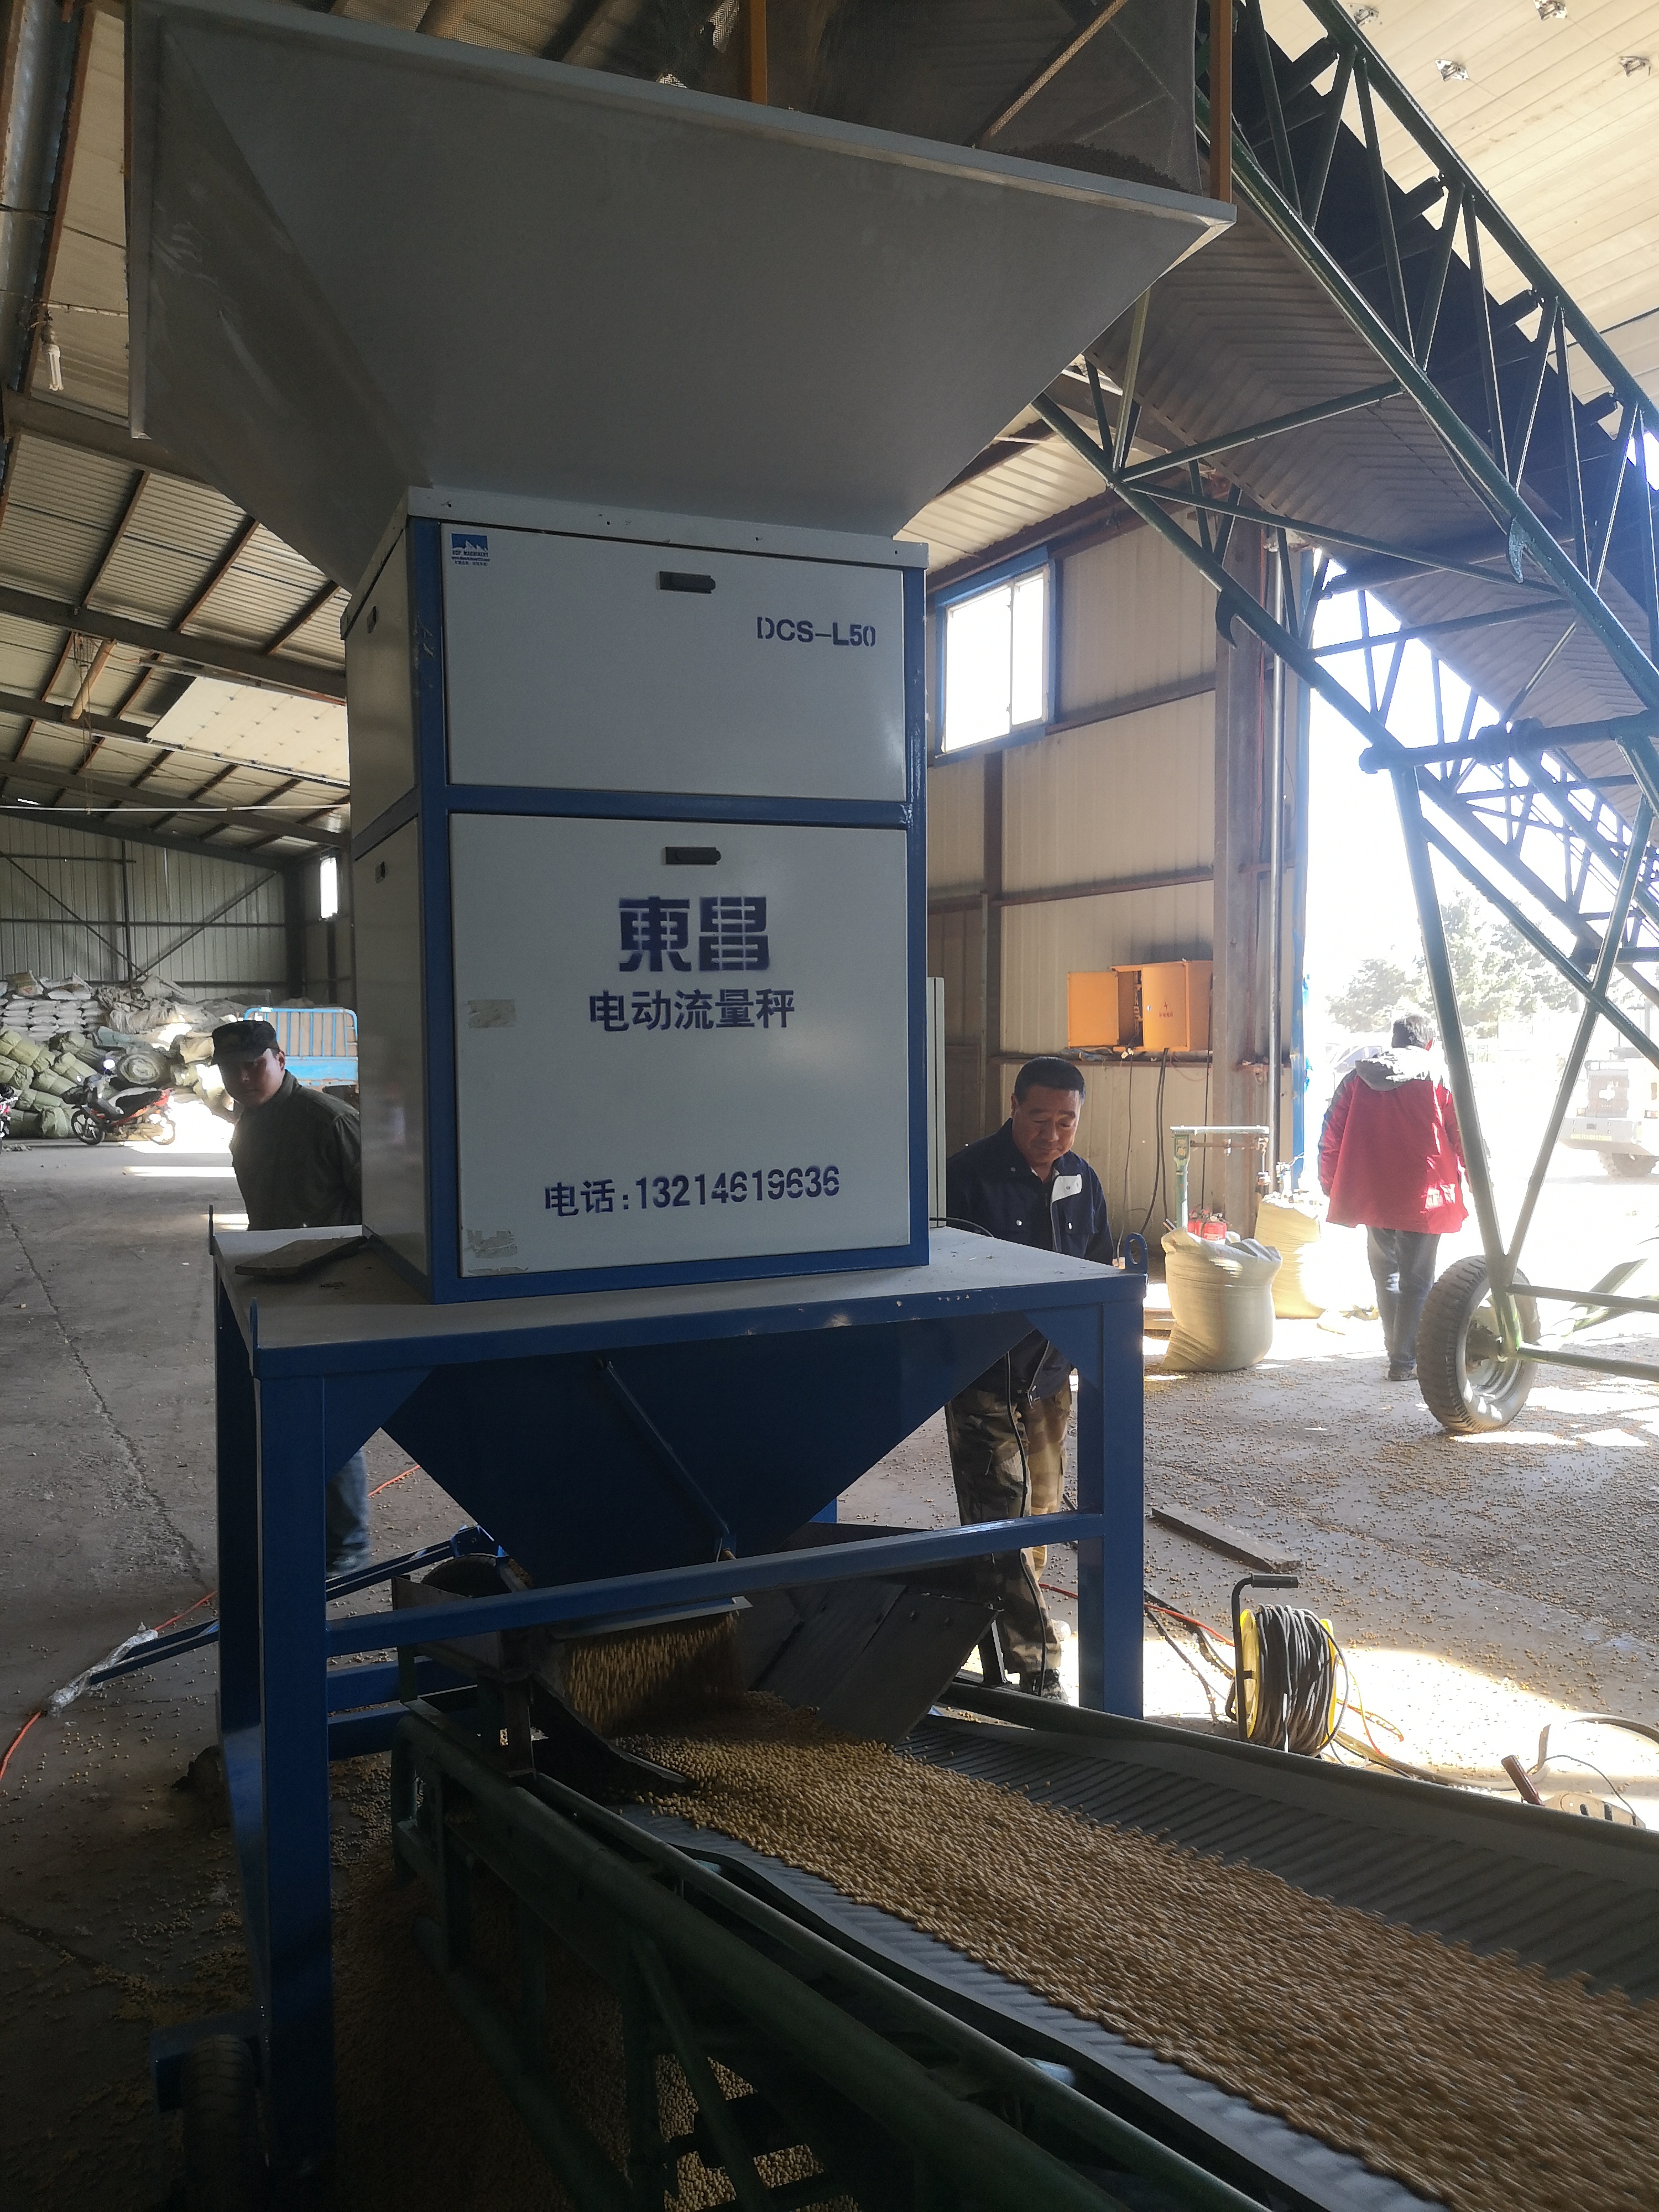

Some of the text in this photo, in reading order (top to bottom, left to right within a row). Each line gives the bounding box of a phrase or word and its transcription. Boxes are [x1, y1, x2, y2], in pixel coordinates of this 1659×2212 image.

[757, 617, 876, 646] DCS-L50
[619, 896, 770, 973] 東昌
[589, 988, 795, 1031] 电动流量秤
